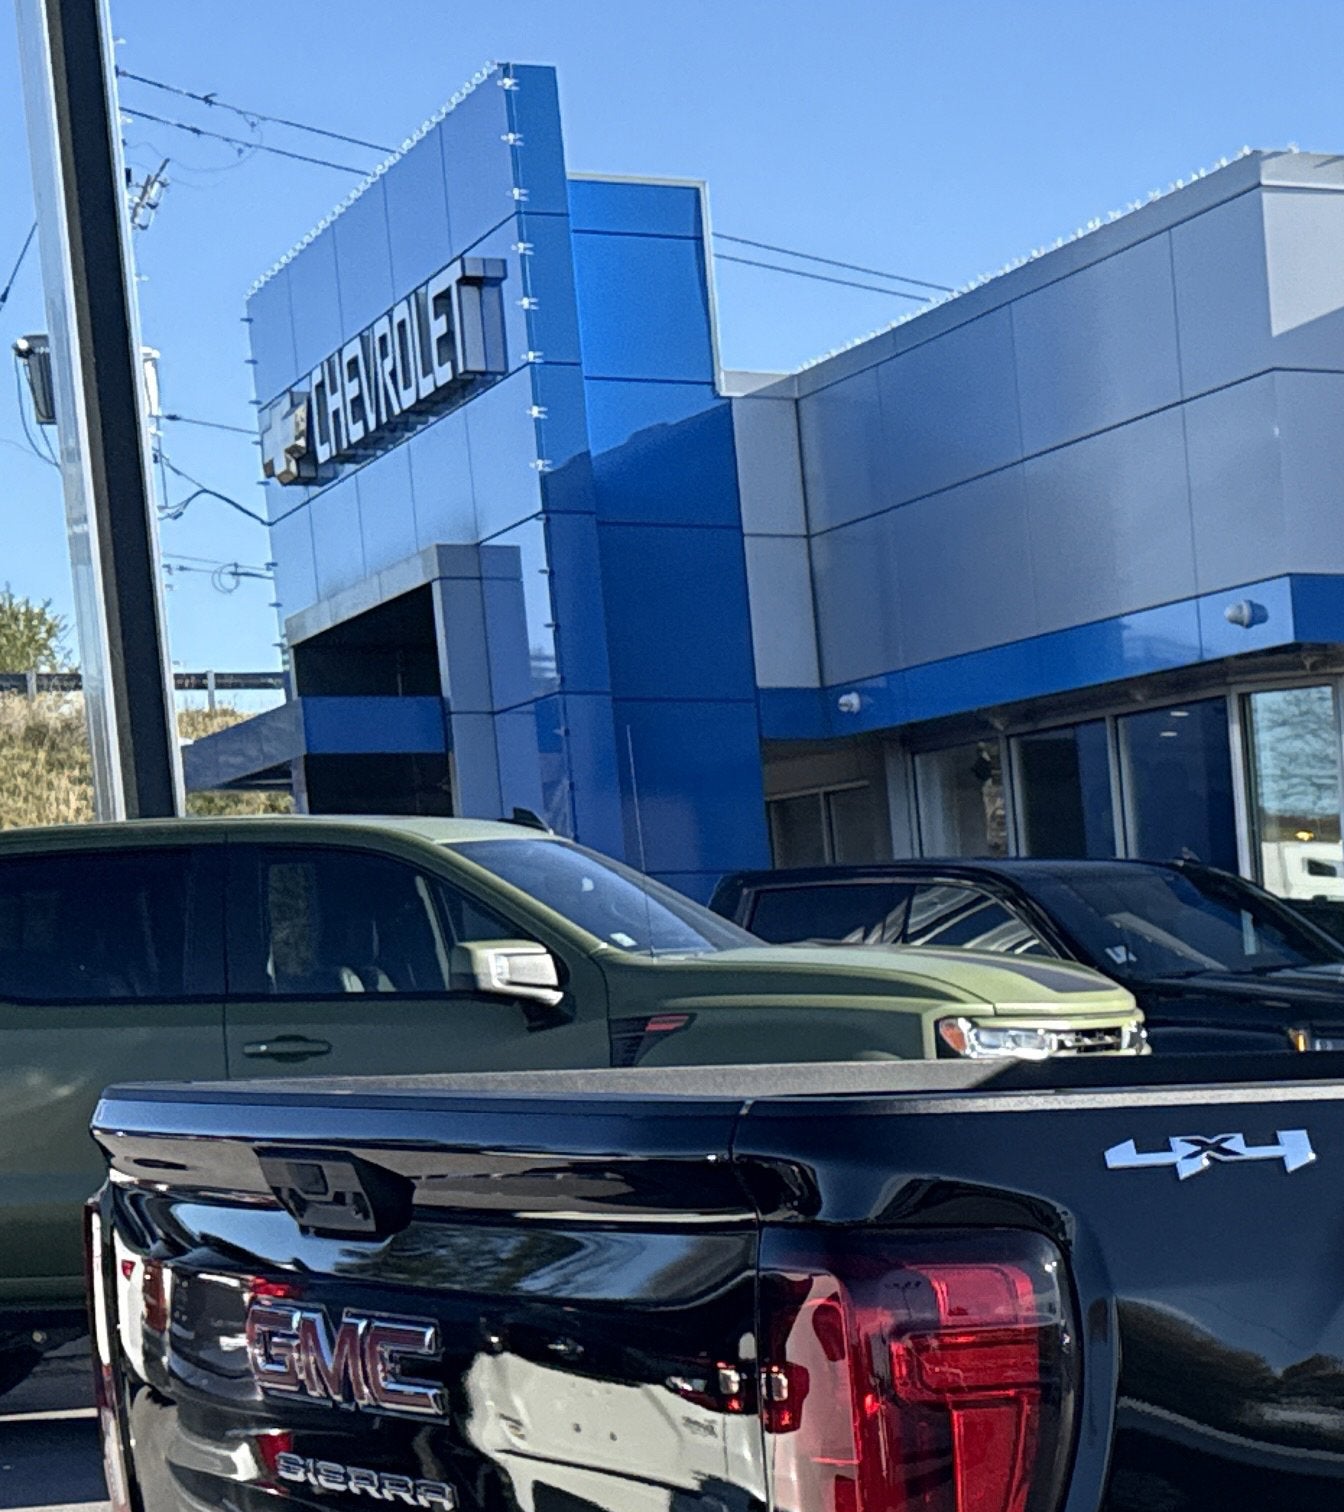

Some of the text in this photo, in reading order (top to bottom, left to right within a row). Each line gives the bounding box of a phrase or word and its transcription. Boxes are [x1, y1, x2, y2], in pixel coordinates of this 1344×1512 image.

[308, 257, 508, 466] CHEVROLET
[246, 1297, 450, 1425] GMC
[275, 1451, 458, 1512] SIERRA
